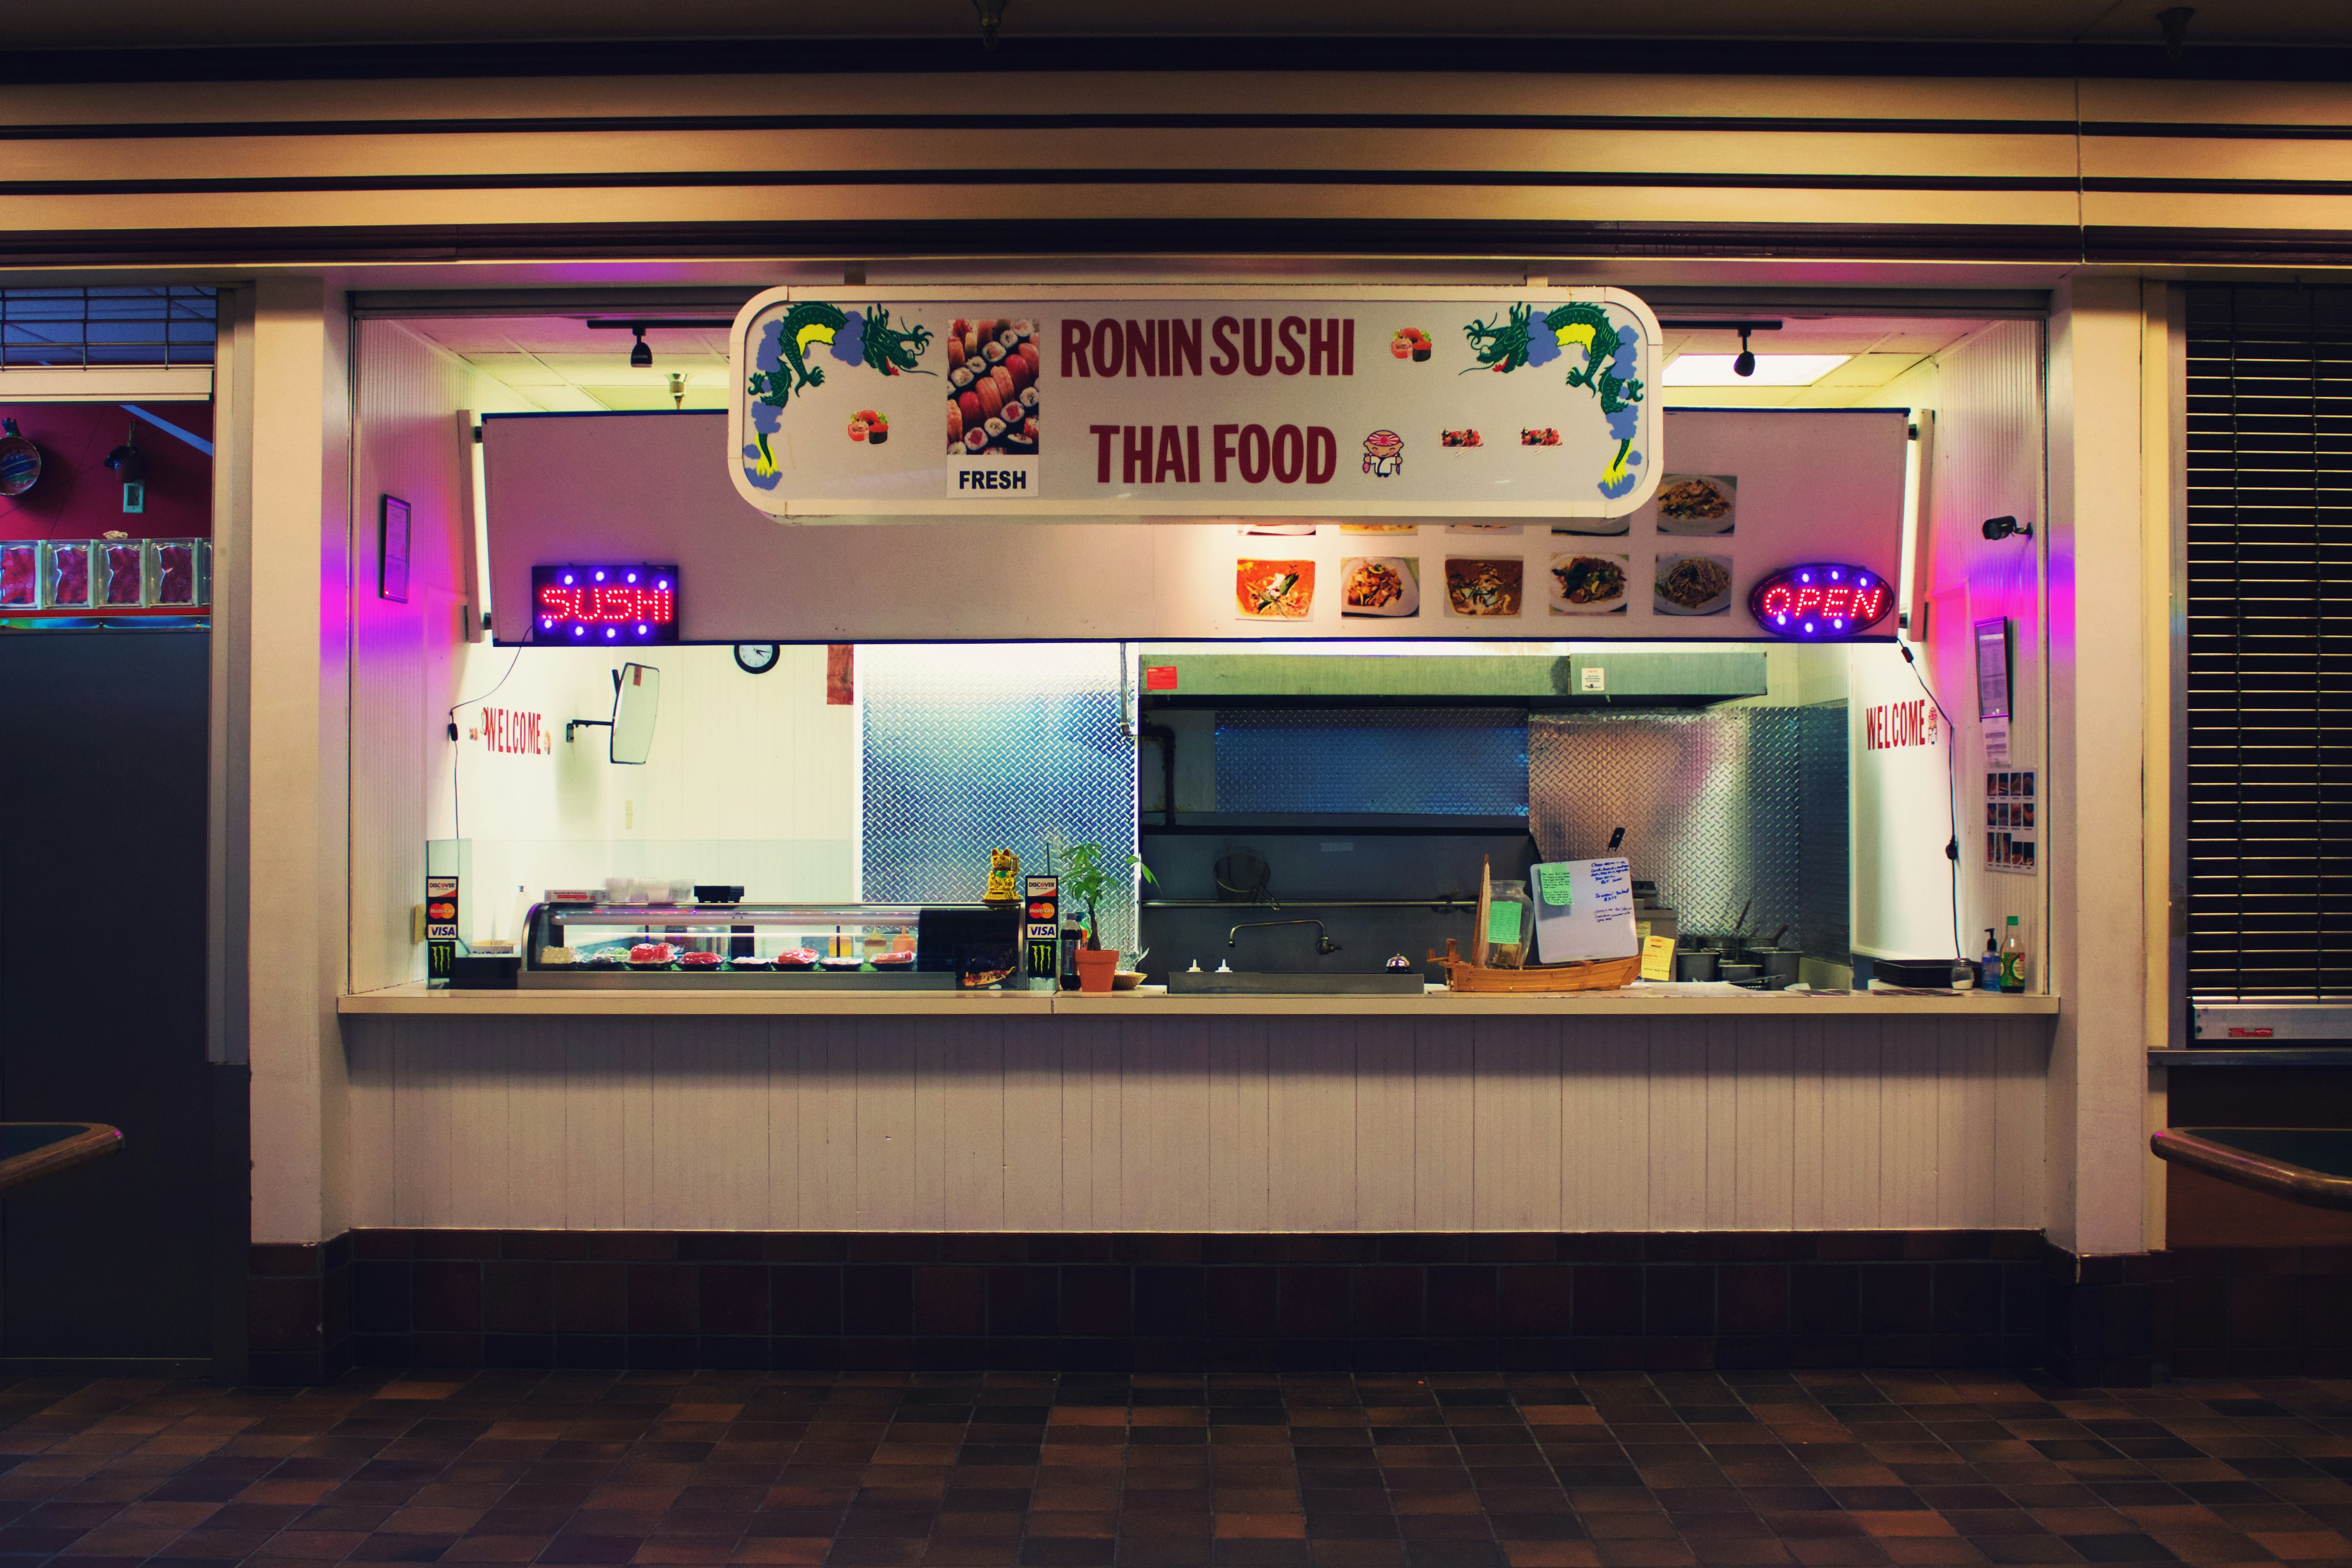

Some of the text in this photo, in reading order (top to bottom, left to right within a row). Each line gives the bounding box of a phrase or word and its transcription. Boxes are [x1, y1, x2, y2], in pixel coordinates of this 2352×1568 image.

[1061, 317, 1354, 378] RONIN SUSHI
[1089, 424, 1337, 485] THAI FOOD
[959, 470, 1026, 490] FRESH
[541, 588, 672, 622] SUSHI
[1765, 587, 1881, 618] OPEN
[483, 707, 541, 755] WELCOME
[1866, 699, 1926, 750] WELCOME
[431, 926, 455, 936] VISA
[1029, 926, 1055, 936] VISA
